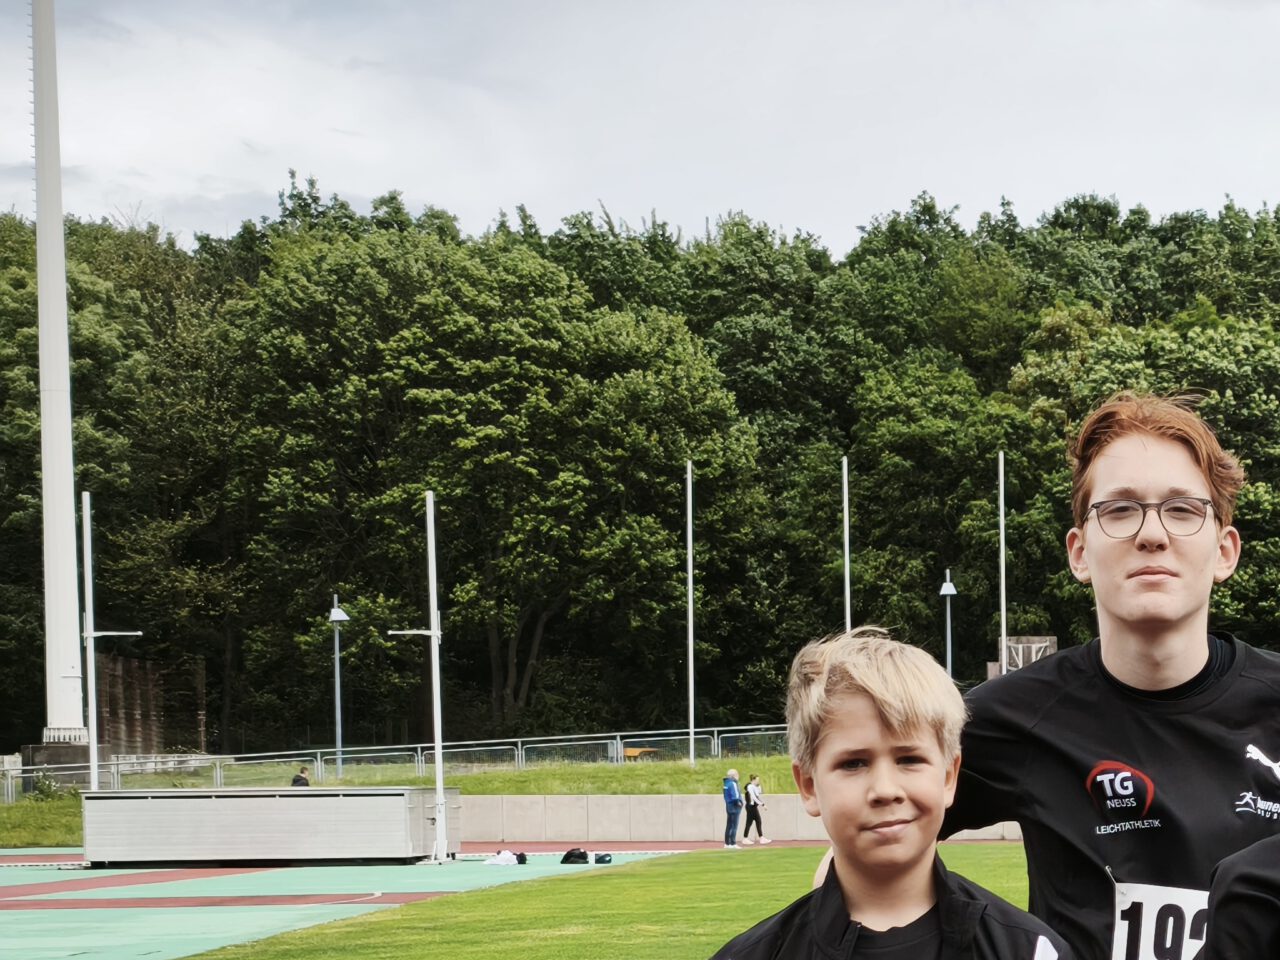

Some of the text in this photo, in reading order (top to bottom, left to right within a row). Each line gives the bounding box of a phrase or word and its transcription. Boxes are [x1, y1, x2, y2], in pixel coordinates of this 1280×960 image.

[1096, 771, 1134, 797] TG
[1106, 798, 1137, 809] NEUSS
[1096, 819, 1161, 835] LEICHTATHLETIK
